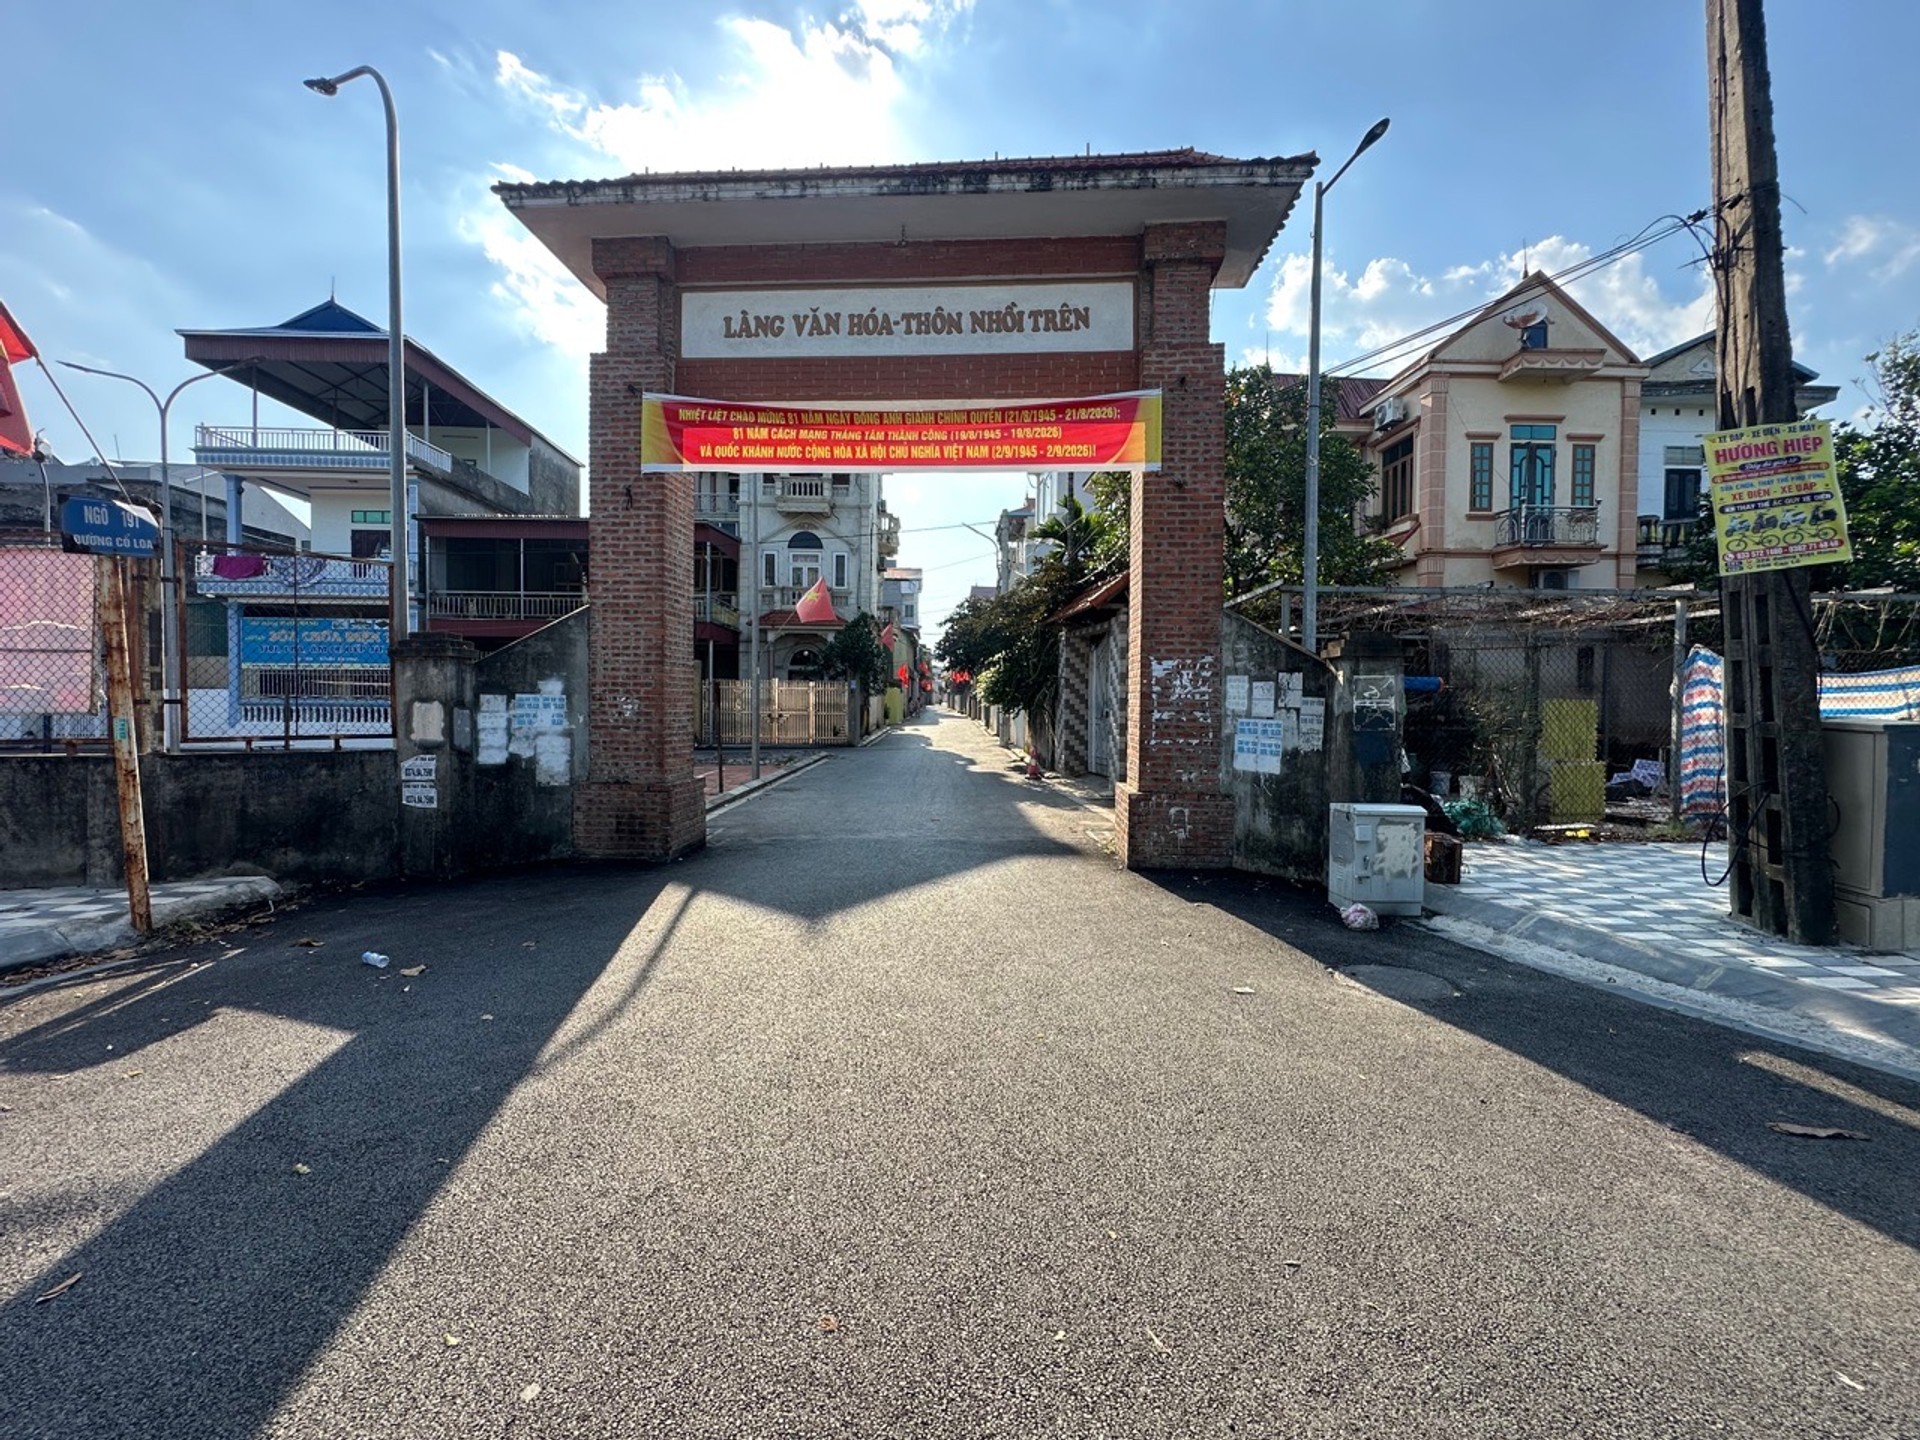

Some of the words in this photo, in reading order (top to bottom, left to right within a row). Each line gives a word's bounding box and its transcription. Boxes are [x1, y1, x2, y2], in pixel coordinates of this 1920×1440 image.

[723, 309, 786, 338] LÀNG
[792, 306, 841, 337] VĂN
[1028, 302, 1091, 332] TRÊN
[679, 408, 706, 424] NHIỆT
[708, 408, 728, 424] LIỆT
[758, 409, 785, 424] MỪNG
[788, 412, 798, 424] 81
[801, 410, 824, 424] NĂM
[883, 412, 903, 424] ANH
[1005, 408, 1056, 424] (21/8/1945
[733, 427, 743, 439] 81
[746, 426, 769, 439] NĂM
[771, 427, 797, 439] CÁCH
[799, 430, 828, 442] MẠNG
[831, 429, 862, 441] THÁNG
[864, 429, 885, 441] TÁM
[888, 429, 919, 441] THÀNH
[921, 428, 948, 441] CÔNG
[950, 429, 1001, 441] (19/8/1945
[1011, 426, 1062, 439] 19/8/2026)
[700, 442, 712, 457] VÀ
[714, 441, 740, 458] QUỐC
[742, 443, 774, 458] KHÁNH
[777, 443, 803, 458] NƯỚC
[805, 443, 831, 461] CỘNG
[833, 443, 853, 458] HÒA
[870, 443, 886, 461] HỘI
[889, 442, 909, 458] CHỦ
[911, 443, 941, 458] NGHĨA
[943, 443, 964, 461] VIỆT
[966, 445, 989, 458] NAM
[992, 445, 1038, 460] (2/9/1945
[1047, 444, 1096, 458] 2/9/2026)!
[1783, 434, 1823, 455] HIỆP
[1732, 493, 1744, 501] XE
[1781, 486, 1793, 494] XE
[134, 539, 153, 549] LOA
